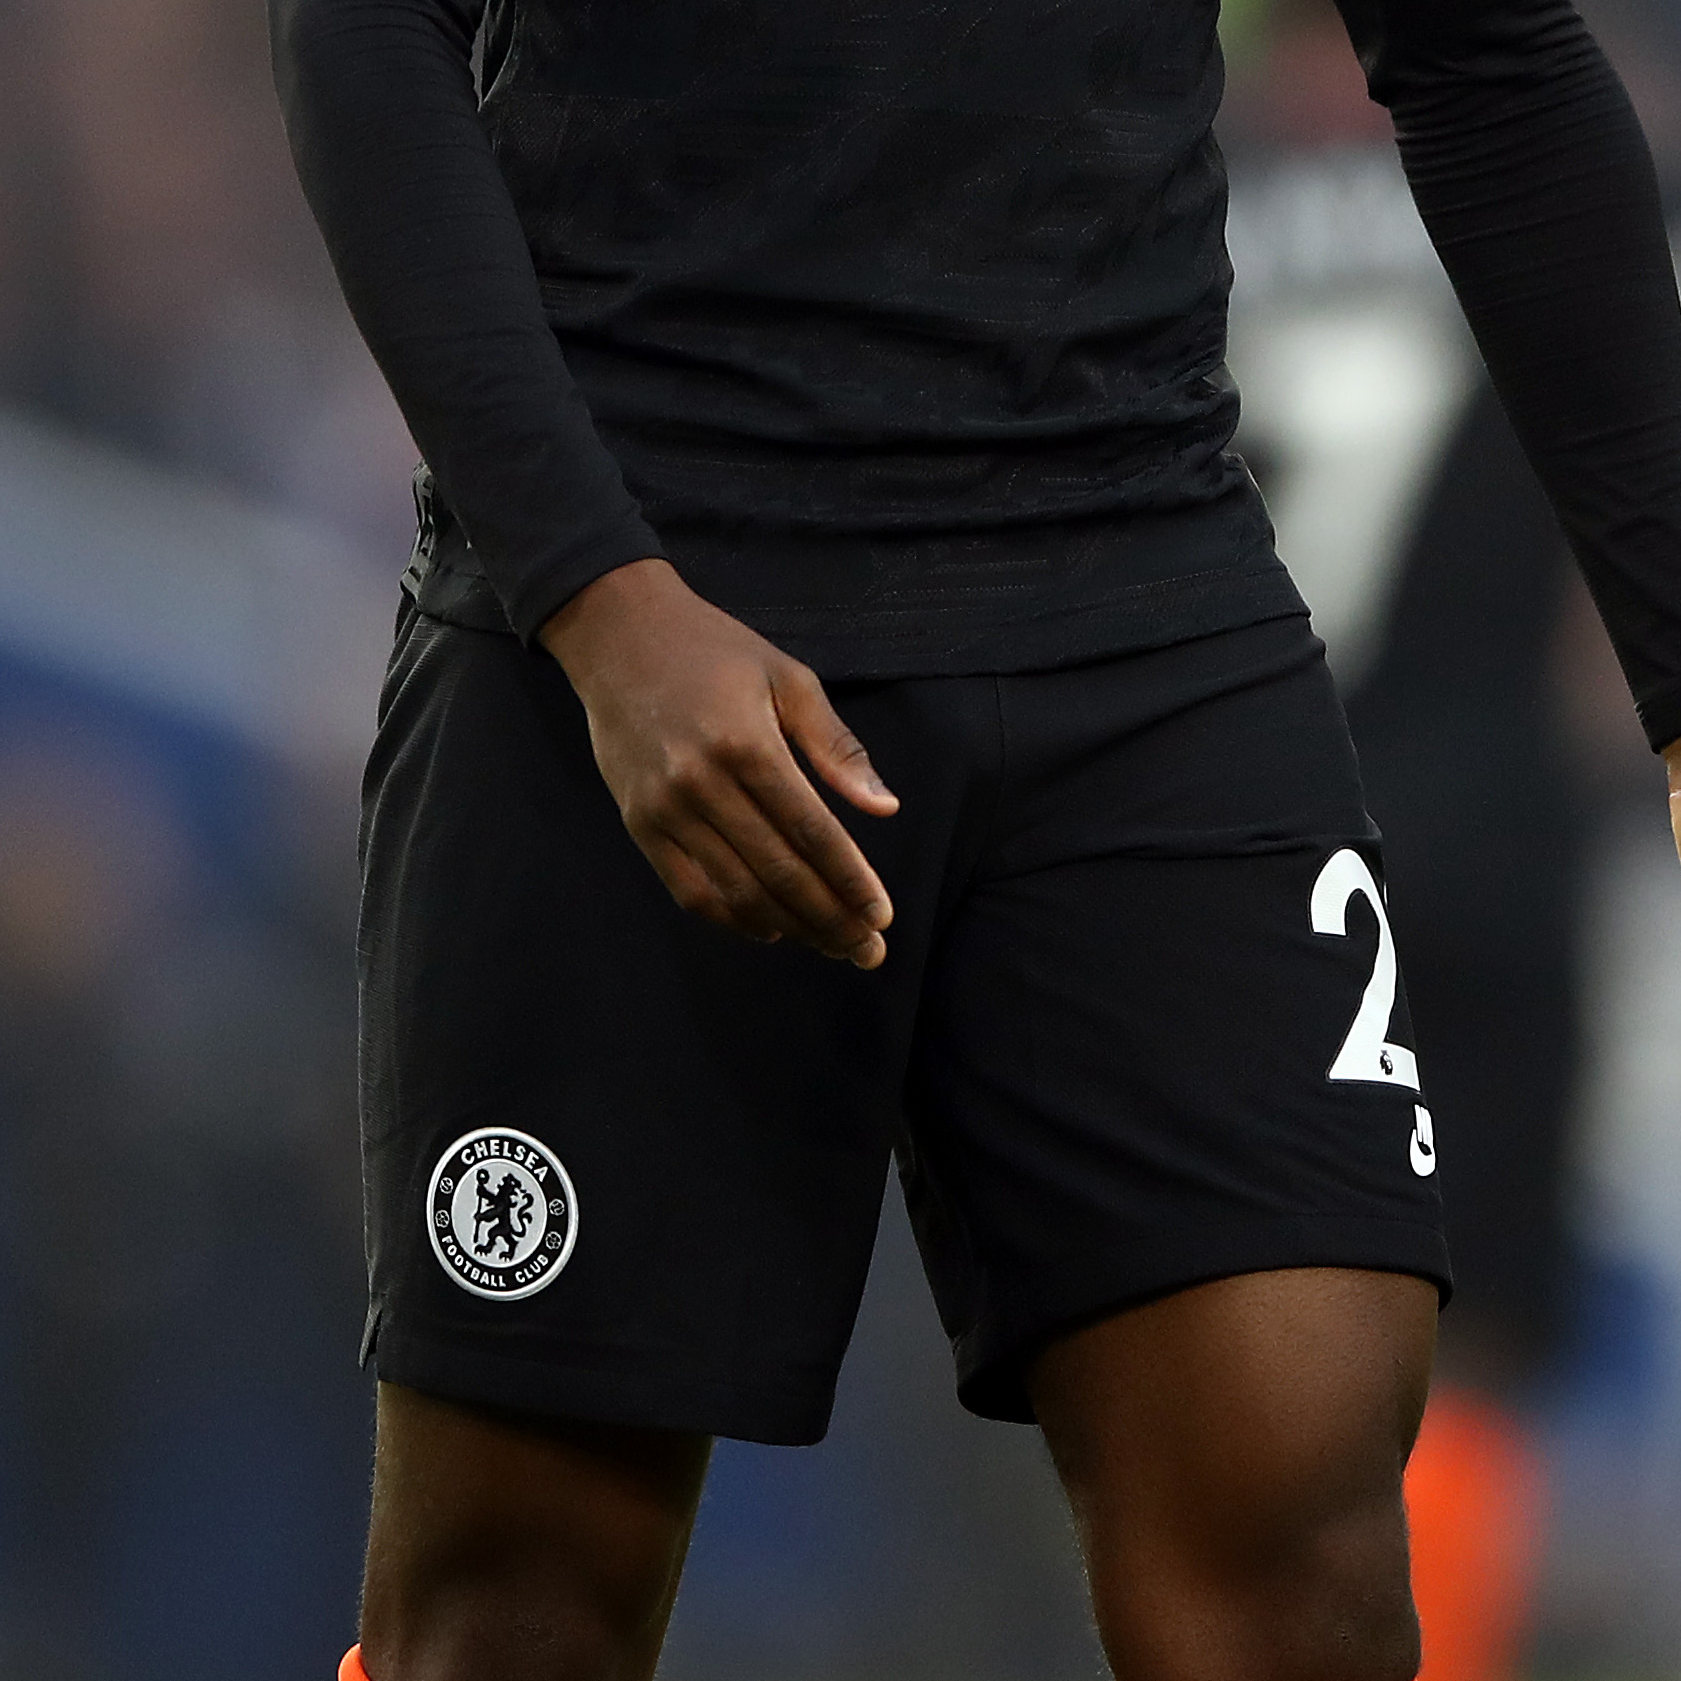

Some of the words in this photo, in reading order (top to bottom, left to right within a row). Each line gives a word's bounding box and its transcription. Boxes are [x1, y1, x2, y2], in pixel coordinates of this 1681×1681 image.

[461, 1139, 549, 1183] CHELSEA
[441, 1235, 507, 1288] FOOTBALL
[515, 1254, 549, 1283] CLUB
